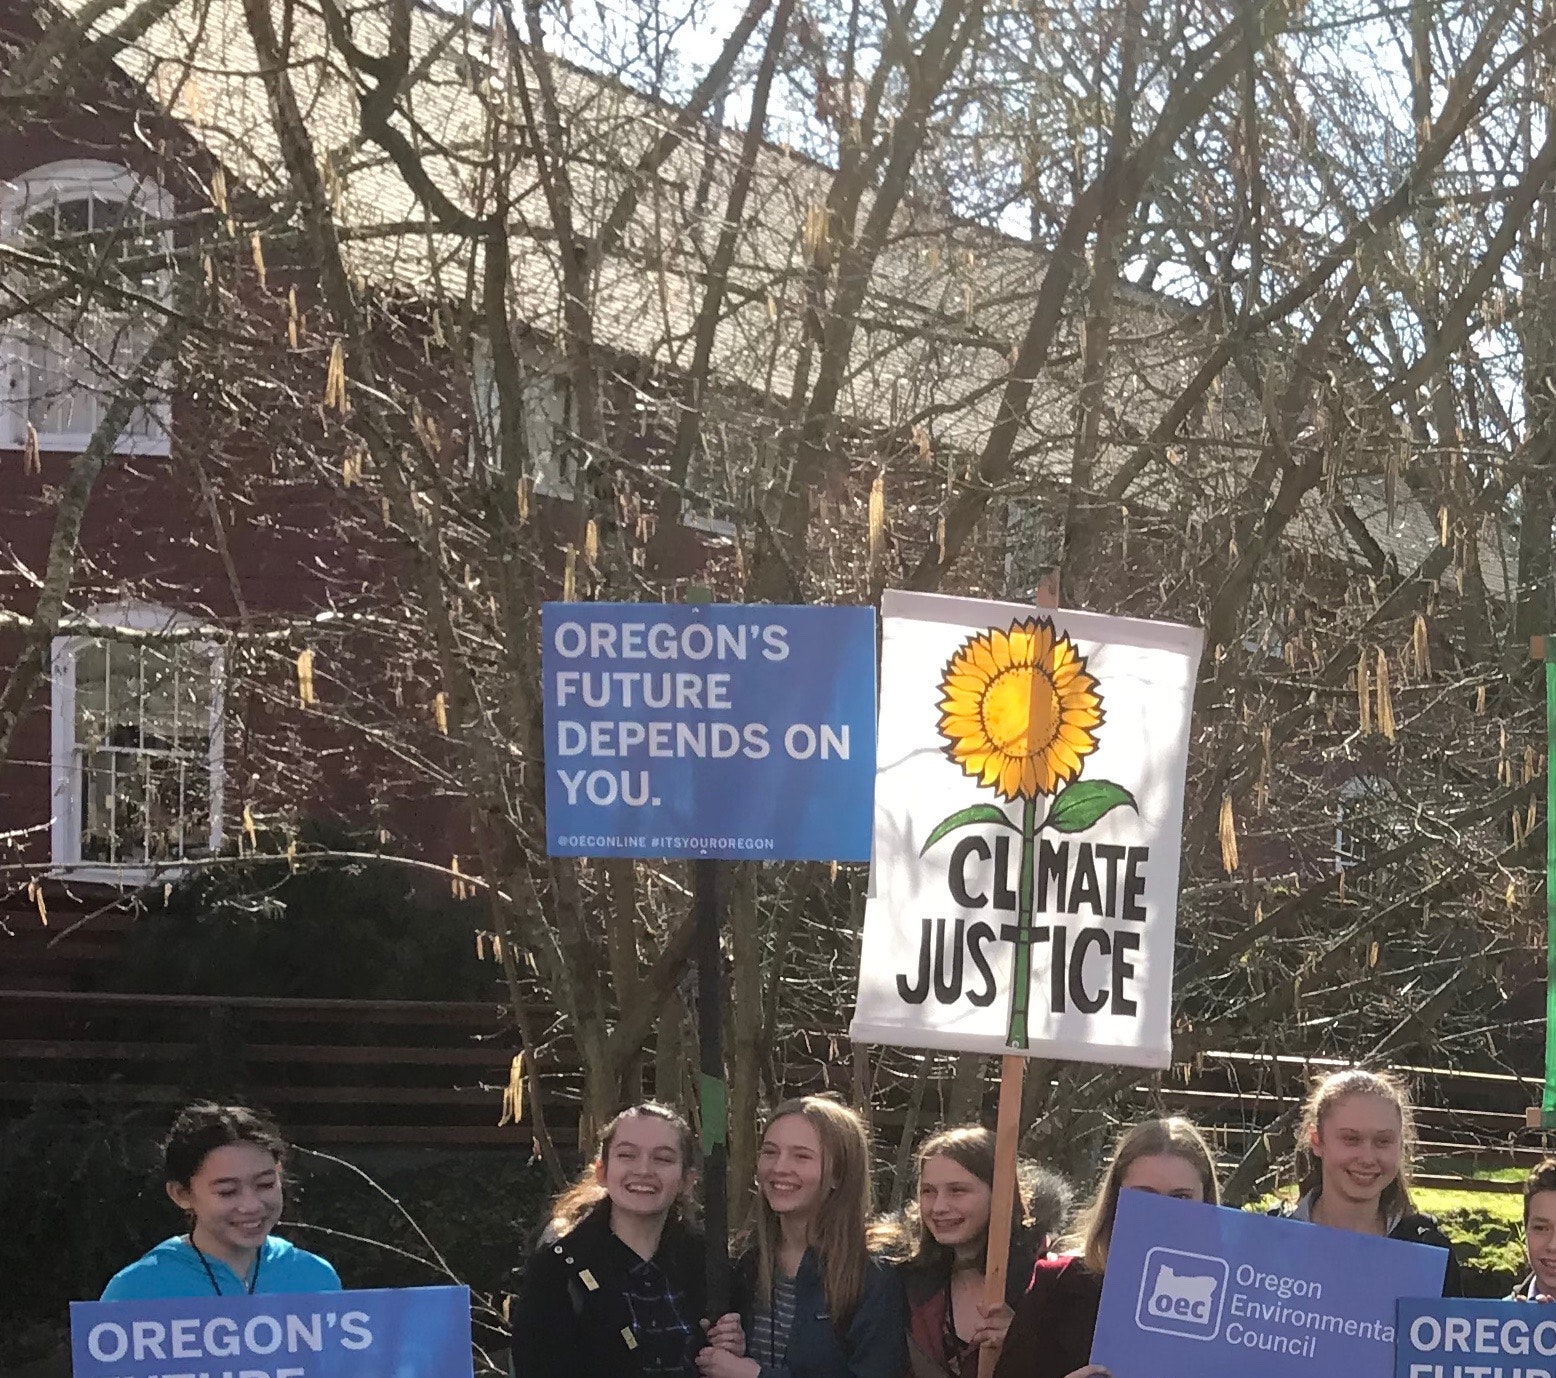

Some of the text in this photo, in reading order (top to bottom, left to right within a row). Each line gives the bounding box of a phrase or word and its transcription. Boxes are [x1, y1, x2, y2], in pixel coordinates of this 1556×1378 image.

[555, 622, 789, 661] OREGON'S
[556, 671, 732, 709] FUTURE
[557, 720, 850, 760] DEPENDS ON
[557, 769, 661, 807] YOU.
[558, 834, 774, 851] @OECONLINE #ITSYOUROREGON
[949, 835, 1149, 921] CLIMATE
[895, 917, 1140, 1016] JUSTICE
[1235, 1264, 1322, 1300] Oregon
[1154, 1294, 1206, 1319] oec
[1230, 1293, 1397, 1343] Environmenta
[88, 1310, 374, 1363] OREGON'S
[1226, 1322, 1317, 1358] Council
